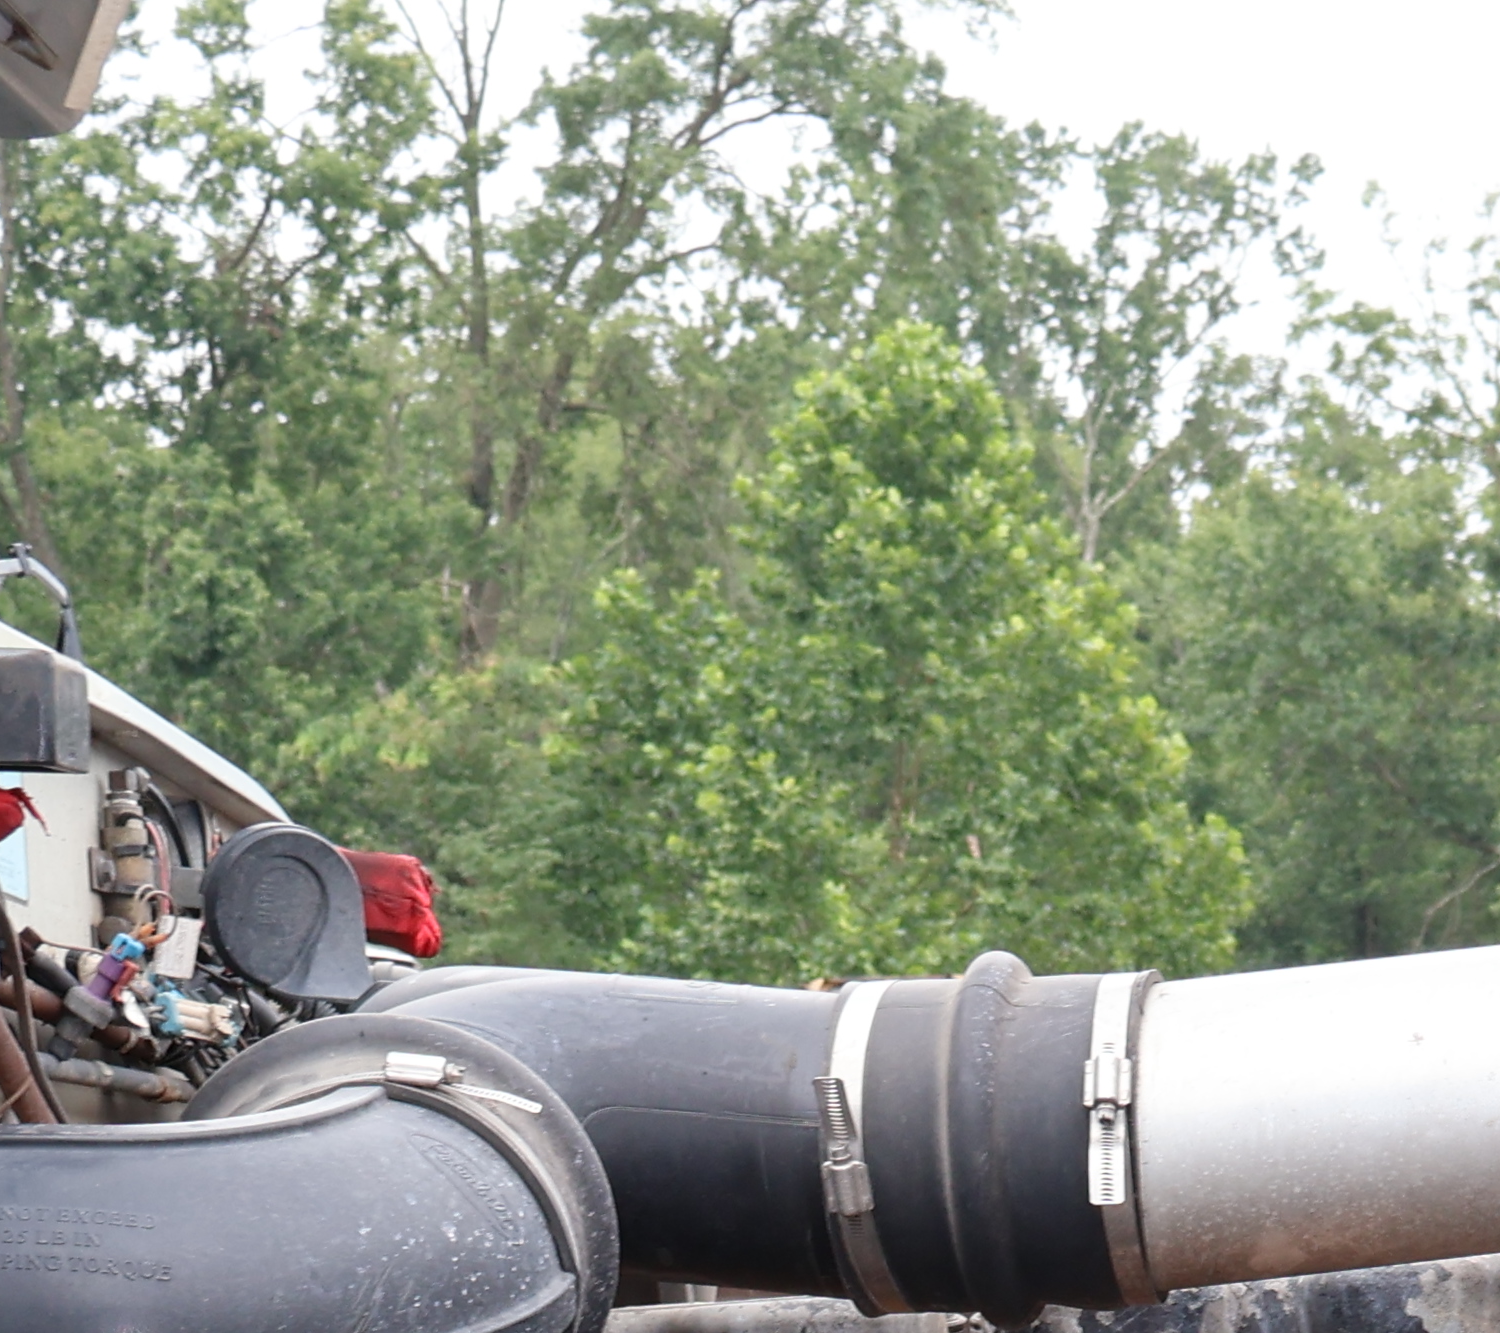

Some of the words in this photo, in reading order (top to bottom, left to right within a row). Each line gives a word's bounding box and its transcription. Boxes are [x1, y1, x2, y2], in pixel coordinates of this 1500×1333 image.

[56, 1207, 156, 1230] EXCEED
[35, 1230, 66, 1246] LB
[68, 1256, 172, 1281] TORQUE
